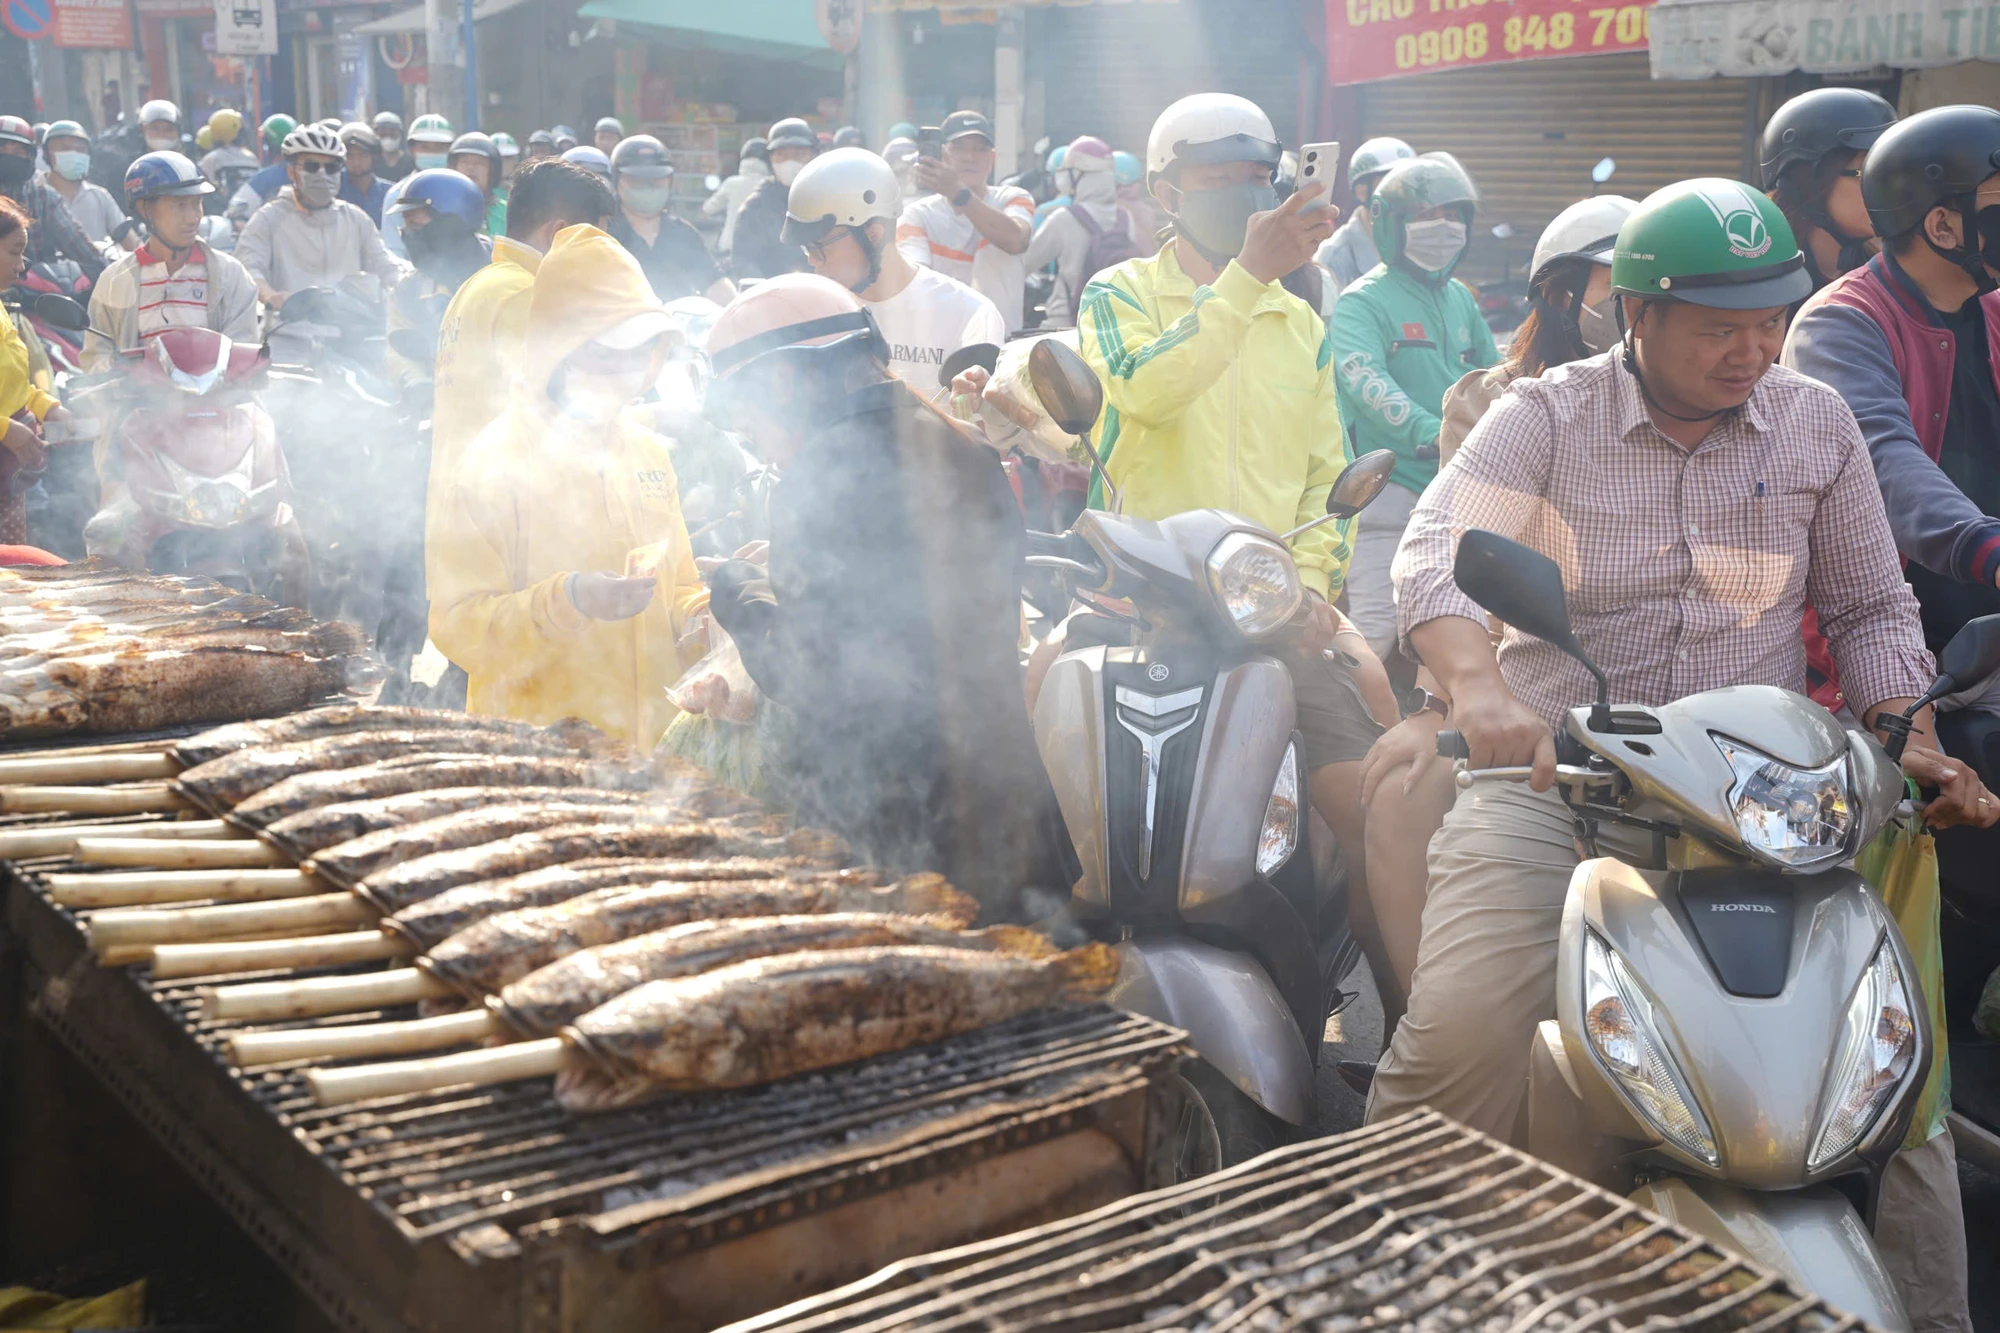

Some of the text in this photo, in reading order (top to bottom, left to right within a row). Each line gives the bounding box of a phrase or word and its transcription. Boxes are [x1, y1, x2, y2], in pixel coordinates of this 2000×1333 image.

[1395, 22, 1488, 69] 0908
[1503, 12, 1575, 54] 848
[1588, 5, 1650, 46] 70
[1806, 4, 1924, 63] BÁNH
[1340, 351, 1410, 425] Grab
[1711, 904, 1777, 913] HONDA
